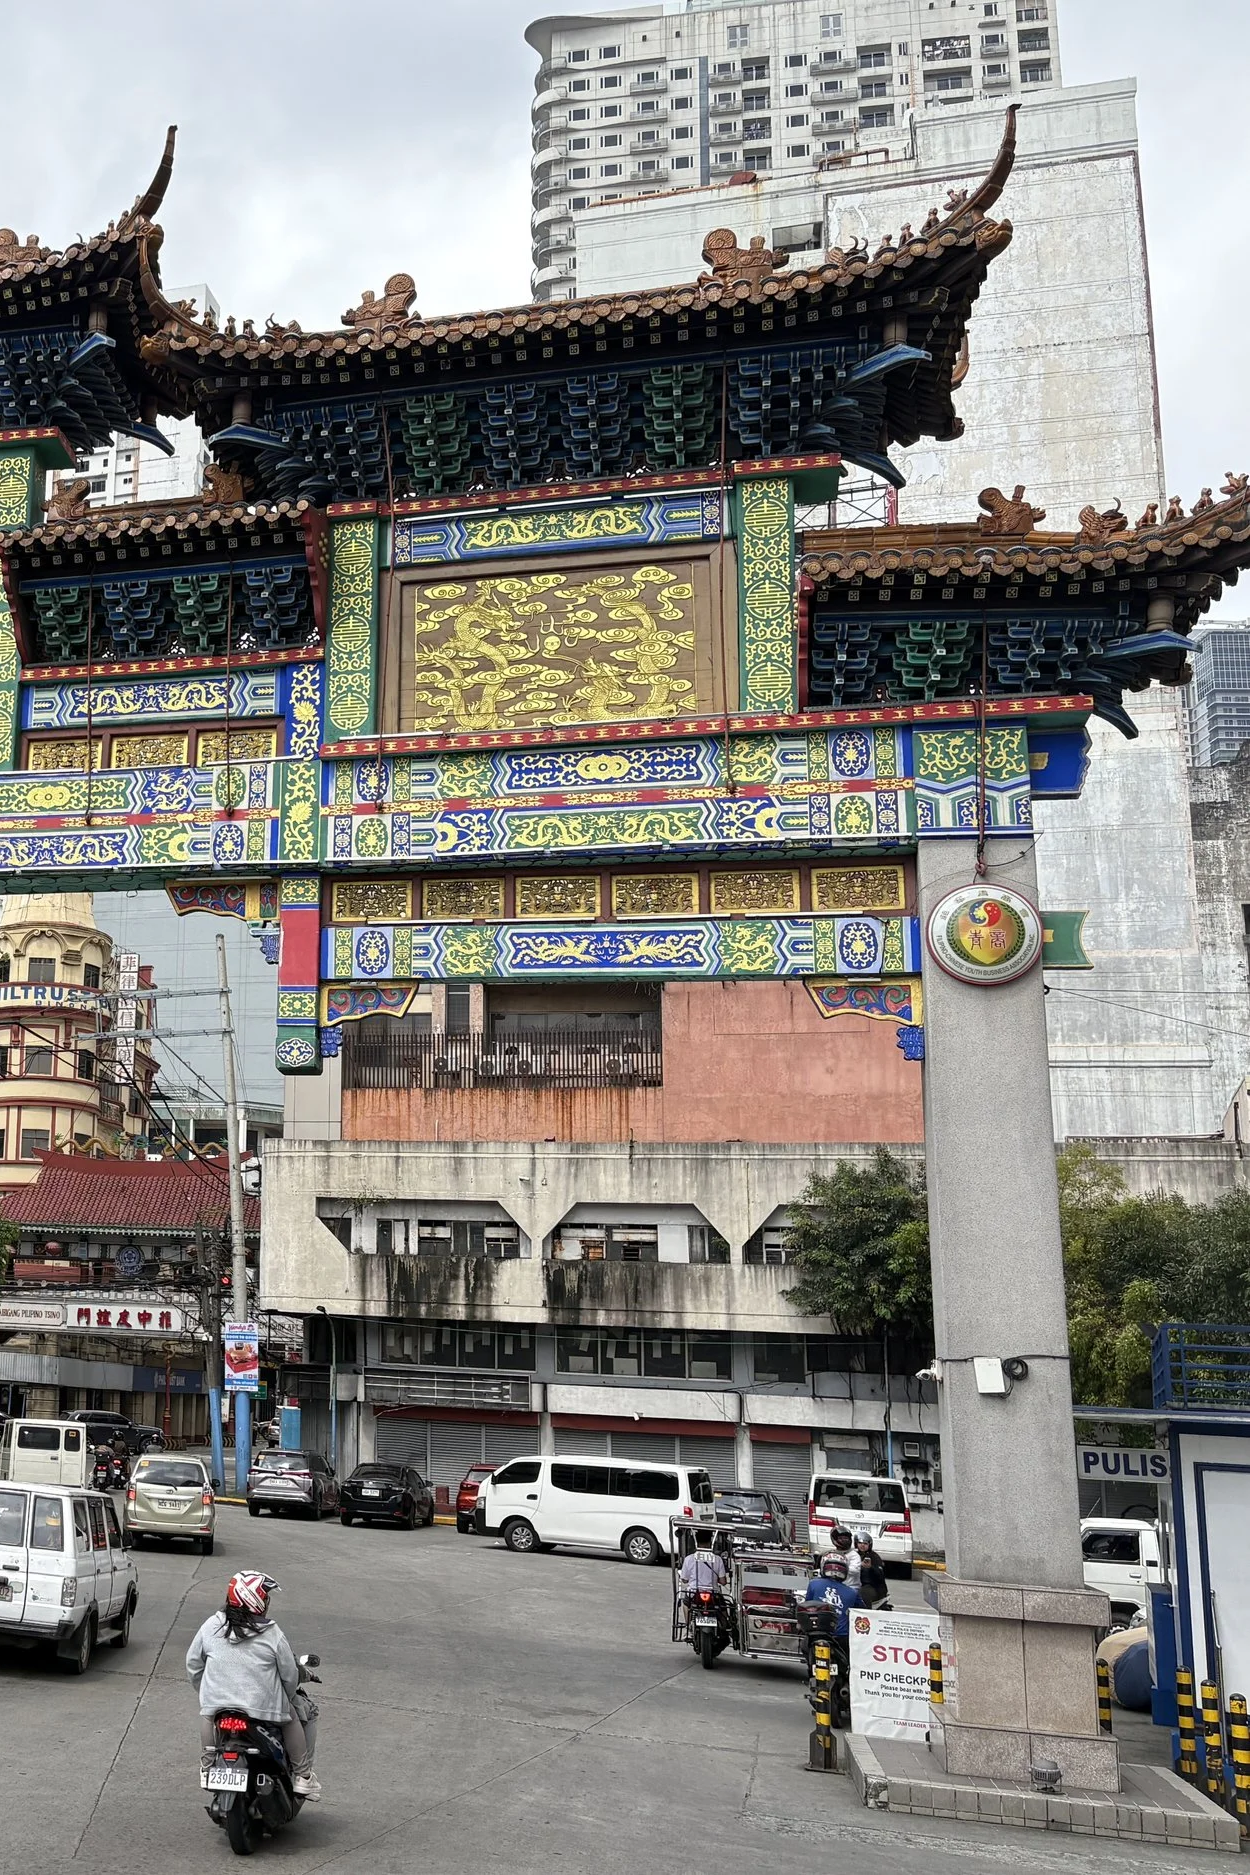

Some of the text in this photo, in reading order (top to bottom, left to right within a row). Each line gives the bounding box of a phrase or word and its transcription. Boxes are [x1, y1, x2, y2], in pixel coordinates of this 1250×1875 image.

[1083, 1451, 1168, 1478] PULIS
[859, 1669, 881, 1681] PNP
[864, 1688, 881, 1697] Thank
[881, 1691, 892, 1699] you
[892, 1691, 901, 1699] for
[901, 1693, 915, 1701] your
[880, 1683, 899, 1692] Please
[899, 1685, 912, 1694] bear
[912, 1687, 924, 1695] with
[210, 1772, 246, 1786] 239DLP
